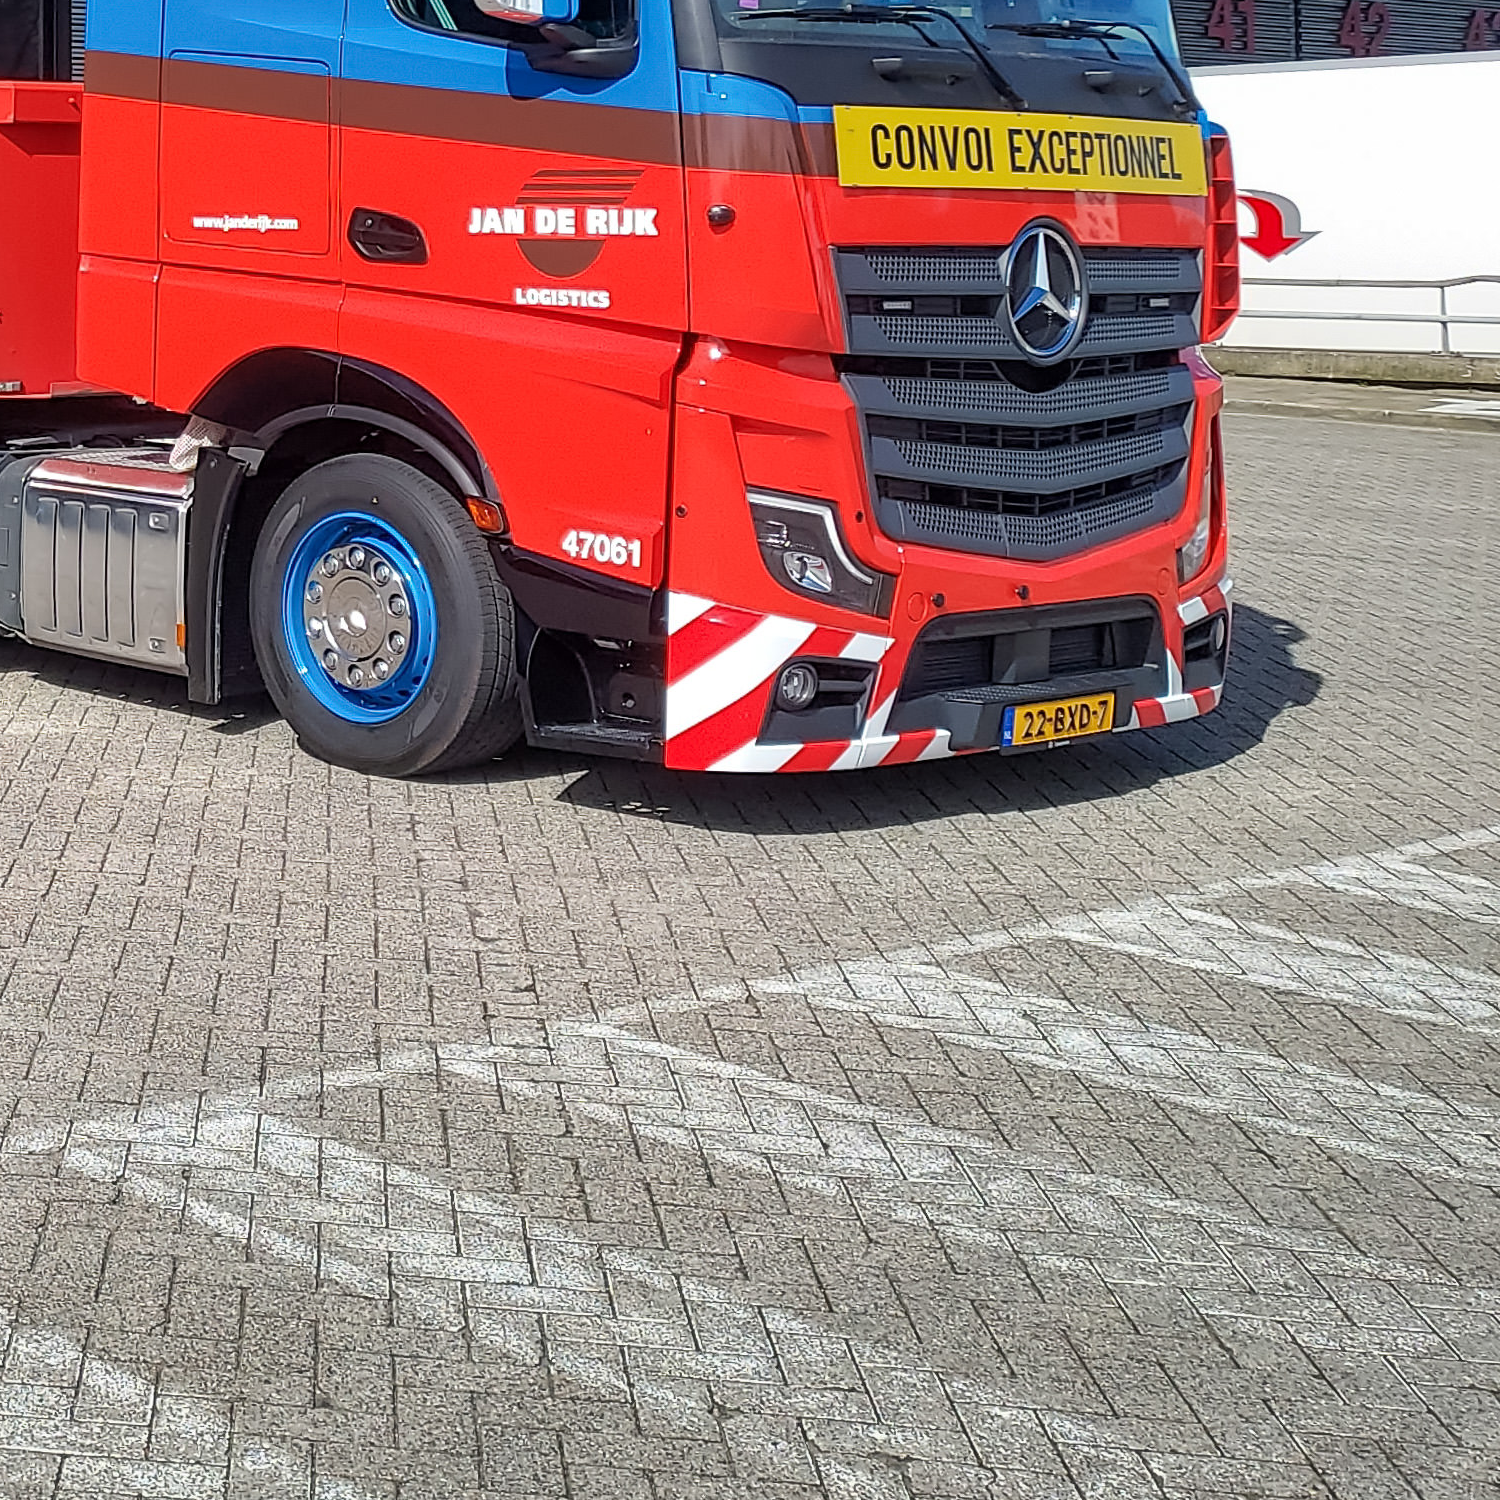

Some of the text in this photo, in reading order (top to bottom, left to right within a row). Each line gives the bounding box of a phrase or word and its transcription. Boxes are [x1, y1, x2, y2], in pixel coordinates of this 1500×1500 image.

[1339, 0, 1391, 57] 42
[870, 123, 1183, 181] CONVOI EXCEPTIONNEL
[192, 214, 299, 233] www.janderijk.com
[468, 207, 659, 236] JAN DE RIJK
[515, 287, 610, 308] LOGISTICS
[561, 529, 642, 568] 47061
[1021, 699, 1109, 740] 22-BXD-7
